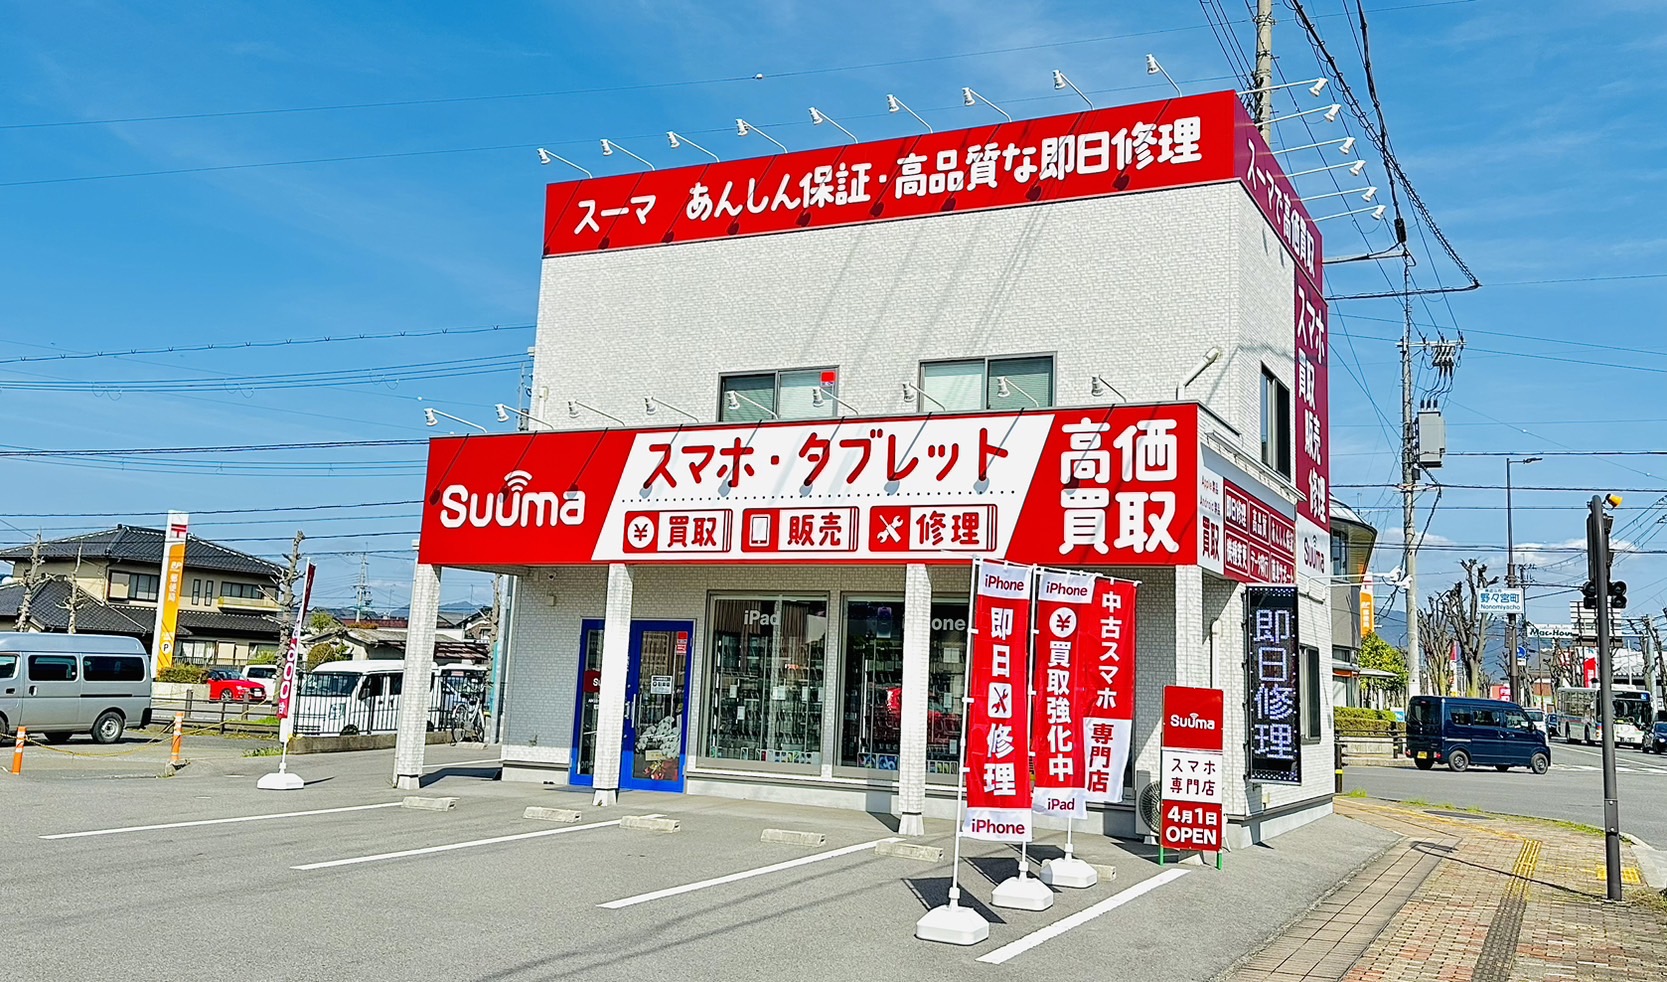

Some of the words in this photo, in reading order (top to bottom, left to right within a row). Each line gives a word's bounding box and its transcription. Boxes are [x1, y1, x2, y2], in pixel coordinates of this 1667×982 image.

[575, 194, 656, 235] スーマ
[686, 115, 1202, 221] あんしん保証・高品質な即日修理
[1247, 138, 1316, 279] スーマで高価買取
[1297, 284, 1325, 364] スマホ
[1298, 348, 1316, 410] 買取
[642, 427, 1009, 488] スマホ・タブレット
[1060, 417, 1178, 484] 高価
[1305, 409, 1321, 466] 販売
[441, 482, 586, 528] Suuma
[1226, 494, 1247, 528] 即日修理
[1308, 467, 1327, 523] 修理
[668, 515, 718, 547] 買取
[788, 511, 842, 547] 販売
[916, 509, 980, 546] 修理
[1059, 487, 1180, 555] 買取
[1203, 516, 1219, 561] 買取
[984, 574, 1024, 591] iPhone
[1046, 581, 1088, 596] iPhone
[1480, 592, 1520, 603] 野々宮町
[744, 610, 781, 625] iPad
[991, 607, 1014, 677] 即日
[1096, 591, 1122, 709] 中古スマホ
[1253, 609, 1292, 760] 即日修理
[1046, 641, 1074, 782] 買取強化中
[1170, 713, 1215, 730] Suuma
[983, 723, 1016, 796] 修理
[1087, 723, 1114, 793] 専門店
[1171, 757, 1216, 774] スマホ
[1047, 797, 1075, 811] iPad
[1169, 776, 1215, 796] 専門店
[971, 818, 1025, 835] iPhone
[1165, 826, 1217, 845] OPEN
[1167, 806, 1217, 824] 4月1日
